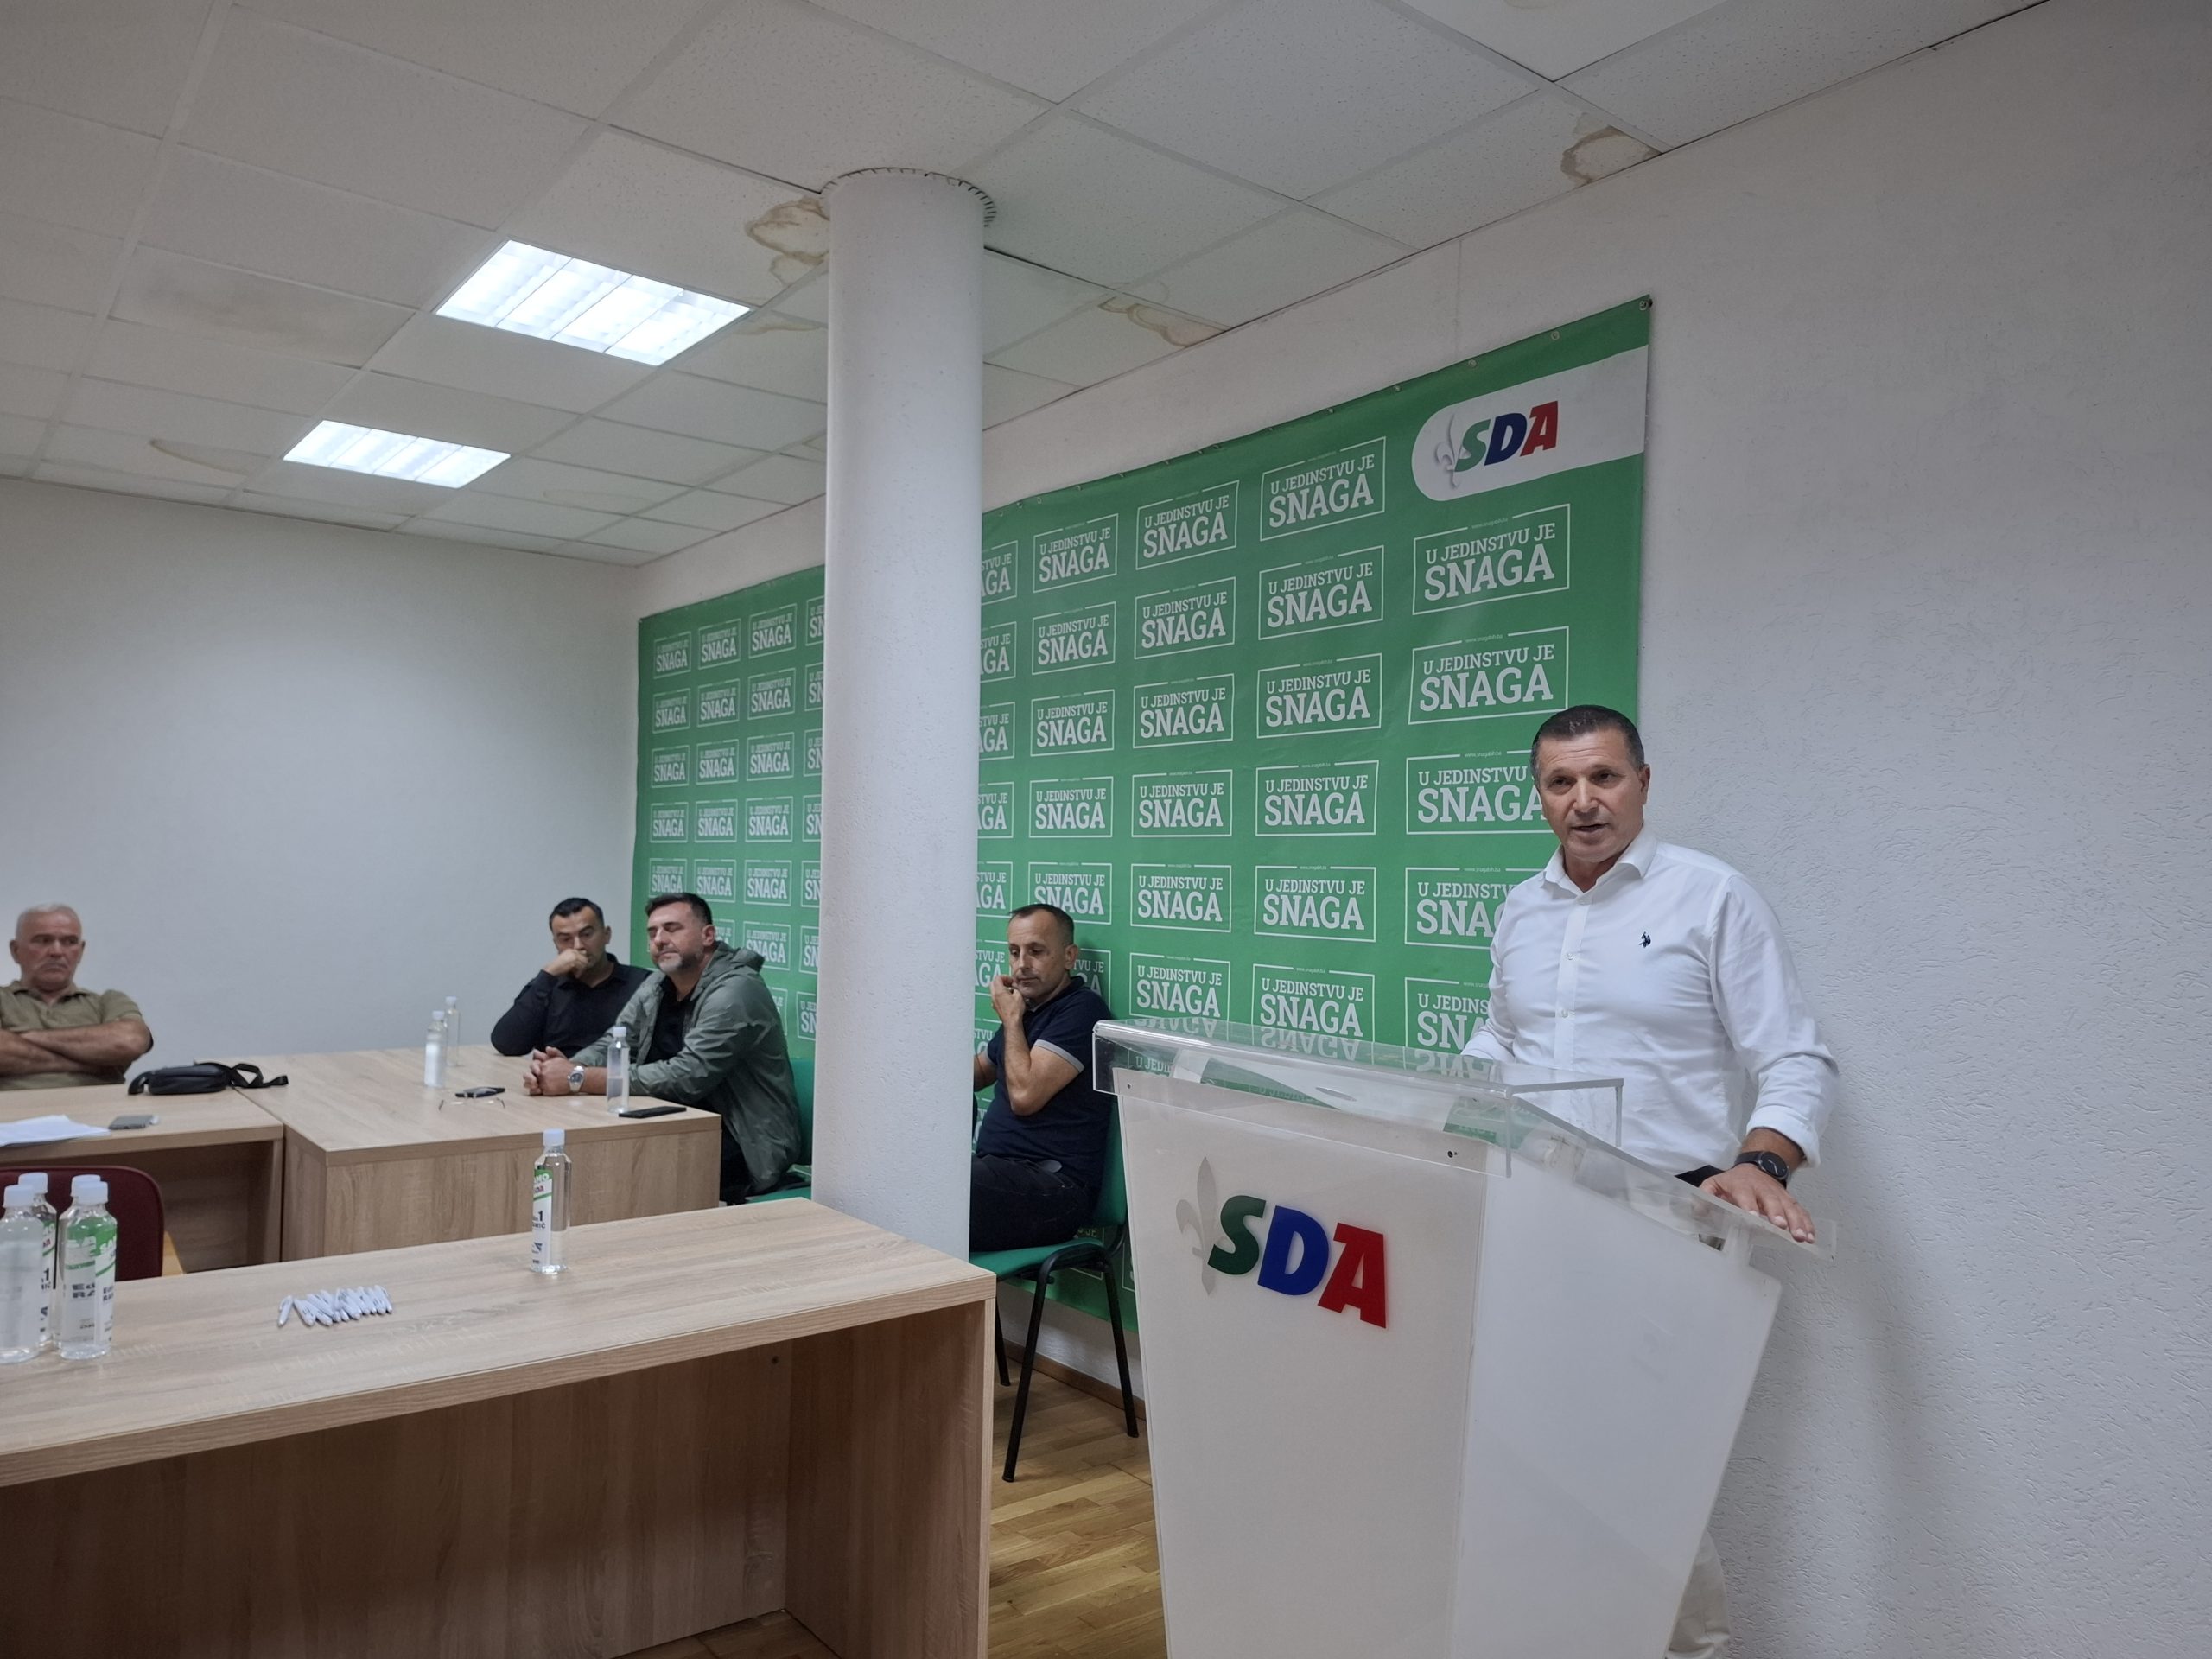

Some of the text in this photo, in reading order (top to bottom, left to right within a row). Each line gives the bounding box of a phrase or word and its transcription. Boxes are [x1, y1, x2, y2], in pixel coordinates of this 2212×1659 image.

[1454, 401, 1559, 472] SDA
[1271, 454, 1374, 494] U JEDINSTVU JE
[1145, 495, 1229, 528] U JEDINSTVU JE
[1270, 474, 1373, 527] SNAGA
[1040, 527, 1110, 555] U JEDINSTVU JE
[1144, 512, 1227, 558] SNAGA
[1426, 523, 1554, 563] U JEDINSTVU JE
[1002, 553, 1011, 565] JE
[1039, 543, 1109, 582] SNAGA
[1269, 562, 1372, 594] U JEDINSTVU JE
[1425, 543, 1554, 601] SNAGA
[1143, 592, 1227, 619] U JEDINSTVU JE
[1268, 581, 1372, 627] SNAGA
[753, 623, 791, 652] SNAGA
[1039, 614, 1109, 638] U JEDINSTVU JE
[1142, 608, 1225, 648] SNAGA
[702, 637, 736, 663] SNAGA
[1000, 633, 1011, 645] JE
[1039, 629, 1108, 664] SNAGA
[657, 649, 687, 672] SNAGA
[1424, 645, 1554, 675] U JEDINSTVU JE
[1267, 669, 1370, 694] U JEDINSTVU JE
[1420, 664, 1553, 711] SNAGA
[701, 696, 735, 721] SNAGA
[752, 687, 791, 713] SNAGA
[1038, 702, 1107, 720] U JEDINSTVU JE
[1141, 688, 1225, 709] U JEDINSTVU JE
[1266, 687, 1370, 727] SNAGA
[656, 706, 686, 727] SNAGA
[999, 714, 1009, 724] JE
[1141, 703, 1224, 738] SNAGA
[1037, 716, 1106, 747] SNAGA
[655, 762, 685, 782] SNAGA
[699, 757, 734, 779] SNAGA
[750, 752, 789, 774] SNAGA
[1419, 766, 1527, 785] U JEDINSTVU
[1037, 788, 1106, 802] U JEDINSTVU JE
[1140, 783, 1224, 798] U JEDINSTVU JE
[1266, 775, 1368, 792] U JEDINSTVU JE
[997, 793, 1007, 804] JE
[1265, 791, 1364, 826] SNAGA
[1418, 785, 1547, 823] SNAGA
[1036, 802, 1105, 829] SNAGA
[1139, 798, 1223, 828] SNAGA
[653, 819, 684, 836] SNAGA
[698, 817, 733, 836] SNAGA
[749, 816, 788, 836] SNAGA
[652, 874, 683, 892] SNAGA
[697, 876, 732, 896] SNAGA
[748, 878, 787, 899] SNAGA
[997, 872, 1007, 883] JE
[1035, 873, 1104, 886] U JEDINSTVU JE
[1139, 876, 1223, 890] U JEDINSTVU JE
[1265, 879, 1364, 894] U JEDINSTVU JE
[1418, 882, 1516, 899] U JEDINSTV
[1138, 889, 1222, 921] SNAGA
[1263, 894, 1364, 930] SNAGA
[1417, 899, 1505, 938] SNA
[995, 952, 1005, 963] JE
[1093, 961, 1104, 973] JE
[1138, 965, 1222, 985] U JEDINSTVU JE
[1137, 980, 1220, 1017] SNAGA
[1262, 978, 1363, 1001] U JEDINSTVU JE
[1261, 995, 1363, 1037] SNAGA
[1418, 994, 1489, 1014] U JEDINS
[1208, 1195, 1386, 1329] SDA
